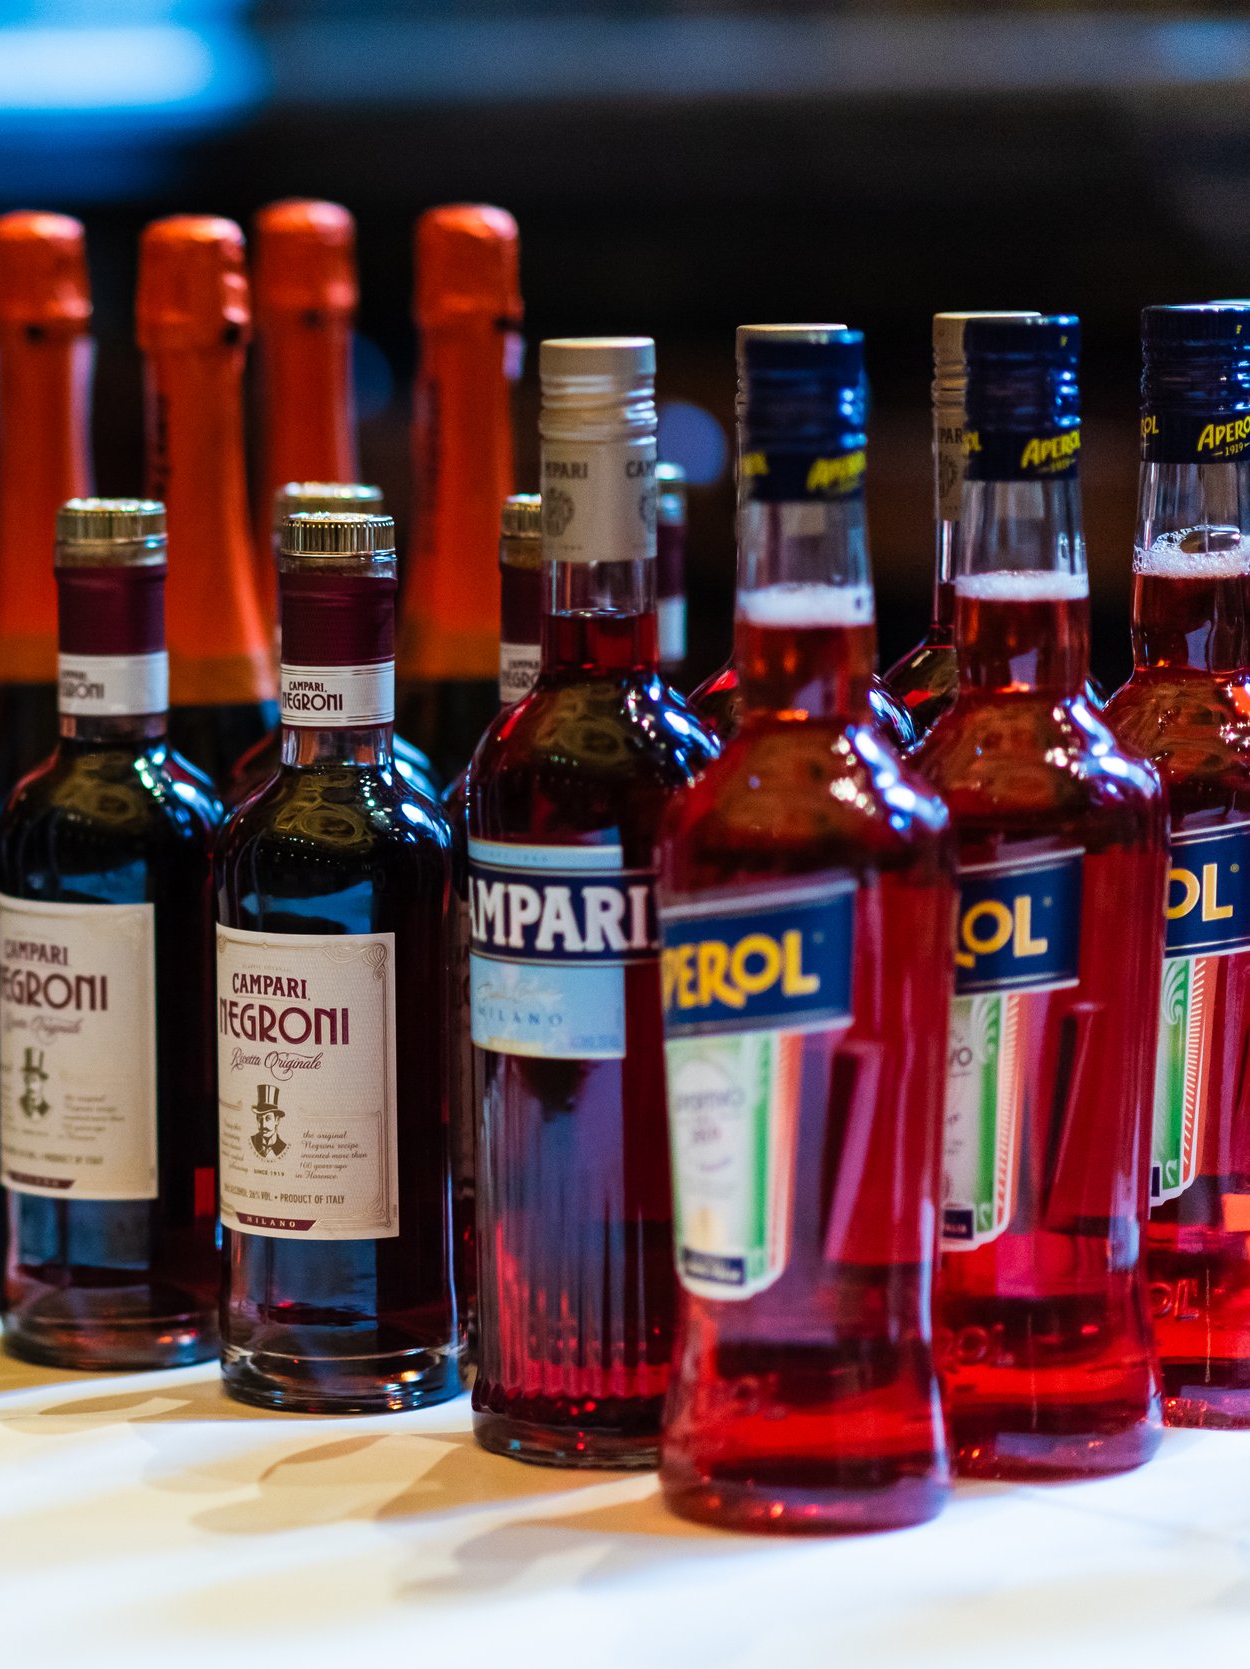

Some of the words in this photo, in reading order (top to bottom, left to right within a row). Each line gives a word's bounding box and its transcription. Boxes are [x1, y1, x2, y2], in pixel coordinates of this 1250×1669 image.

[283, 692, 343, 711] NEGRONI
[953, 894, 1048, 968] OL
[219, 996, 350, 1046] NEGRONI
[264, 1050, 324, 1081] Originale
[280, 1193, 312, 1204] PRODUCT
[314, 1194, 323, 1204] OF
[325, 1194, 345, 1205] ITALY
[246, 1216, 297, 1228] MILANO
